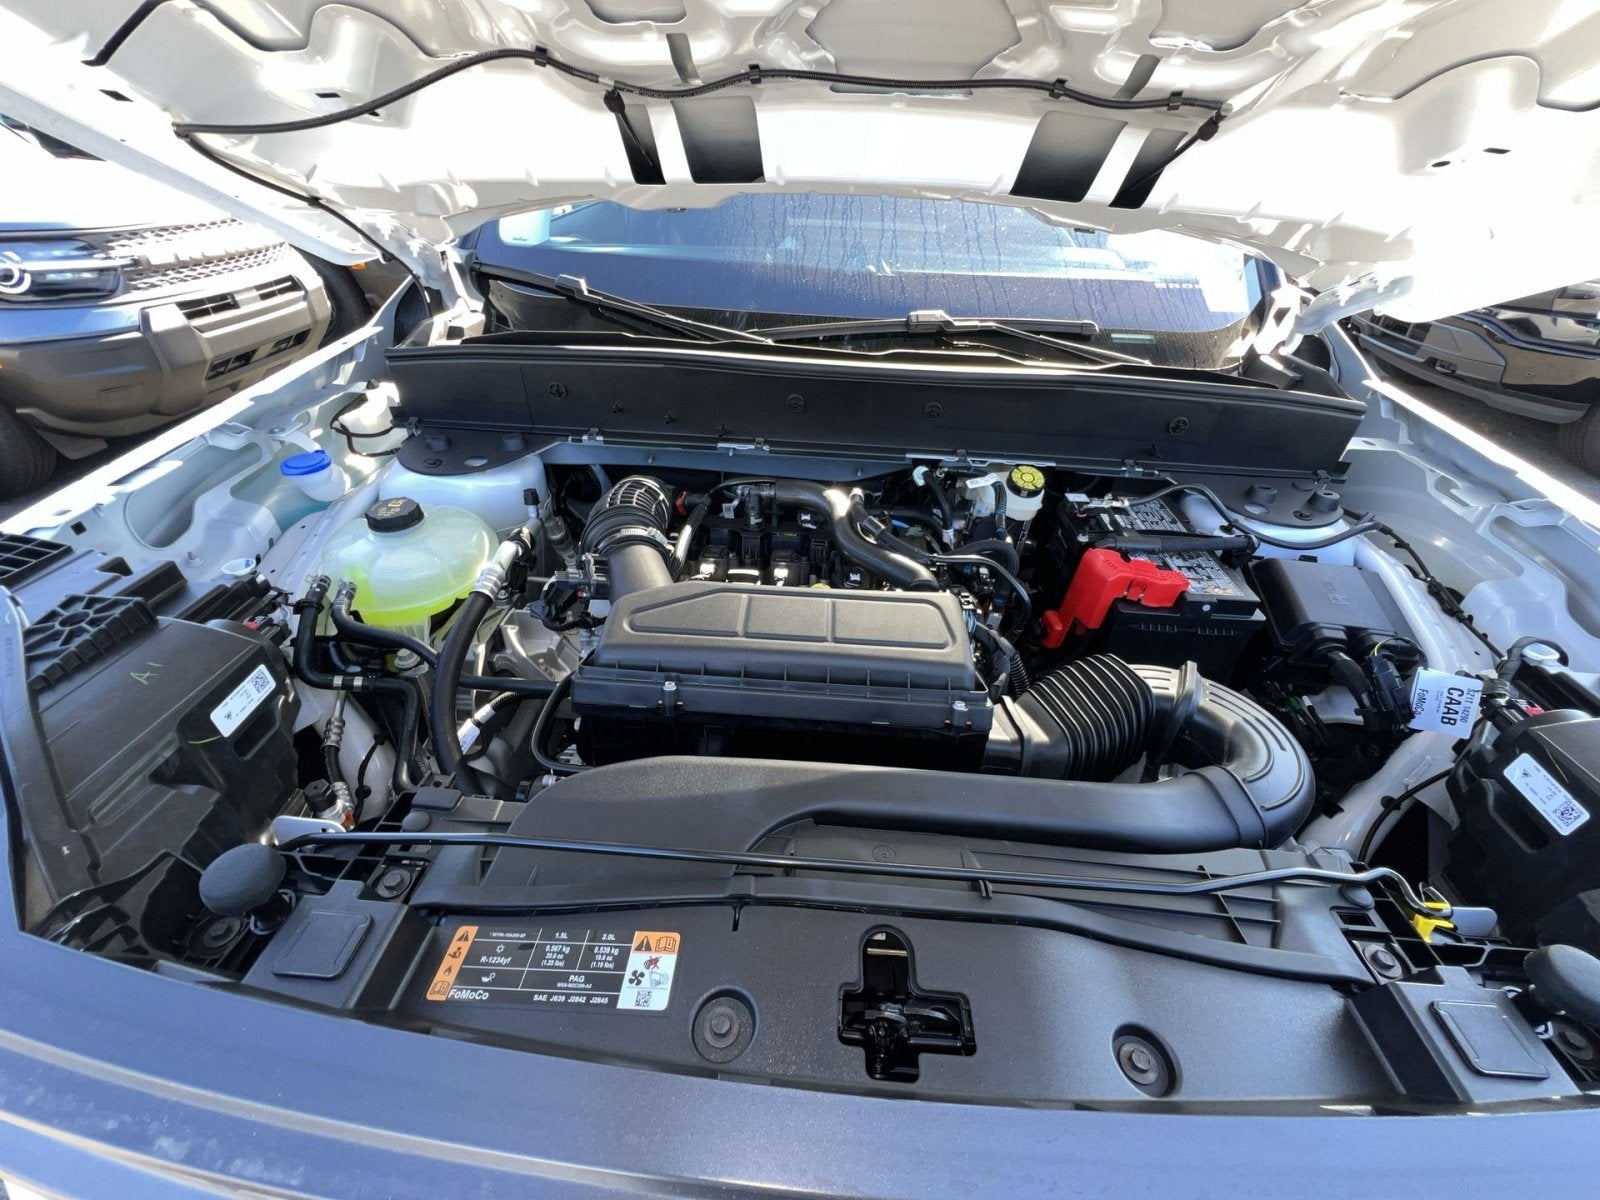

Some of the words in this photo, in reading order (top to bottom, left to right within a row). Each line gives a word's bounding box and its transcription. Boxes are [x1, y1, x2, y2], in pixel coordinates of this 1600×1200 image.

[1413, 688, 1429, 716] FoMoCo
[1440, 687, 1465, 726] CAAB
[602, 933, 616, 941] 2.0L
[562, 946, 571, 954] kg
[610, 947, 619, 956] kg
[480, 956, 512, 965] R-1234yf
[568, 974, 585, 983] PAG
[448, 989, 490, 1000] FoMoCo
